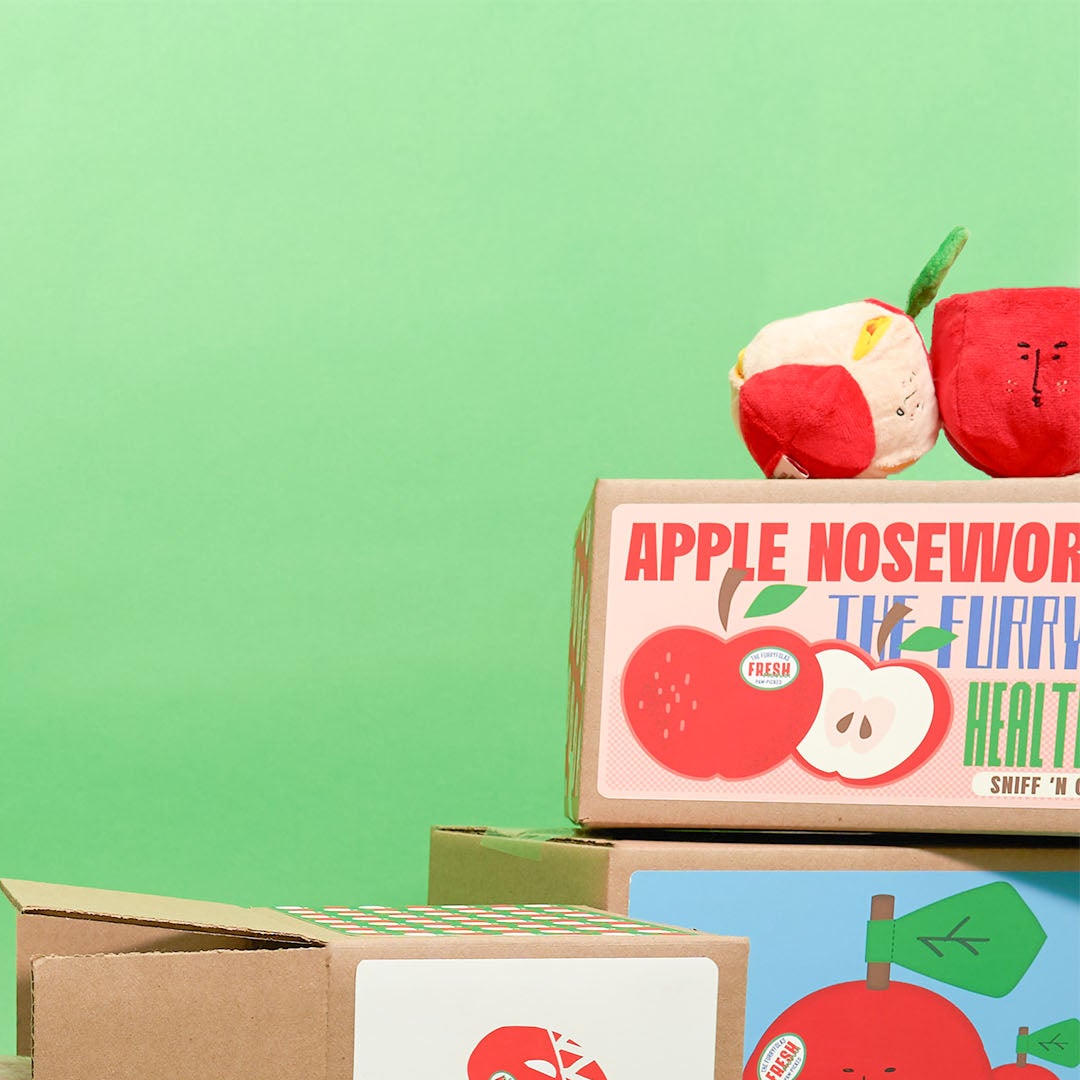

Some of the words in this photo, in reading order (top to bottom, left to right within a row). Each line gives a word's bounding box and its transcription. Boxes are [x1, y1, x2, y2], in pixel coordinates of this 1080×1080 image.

[624, 522, 789, 582] APPLE
[807, 521, 1080, 583] NOSEWOR
[828, 594, 919, 661] THE
[748, 661, 791, 677] FRESH
[963, 681, 1080, 768] HEALT
[990, 775, 1042, 795] SNIFF
